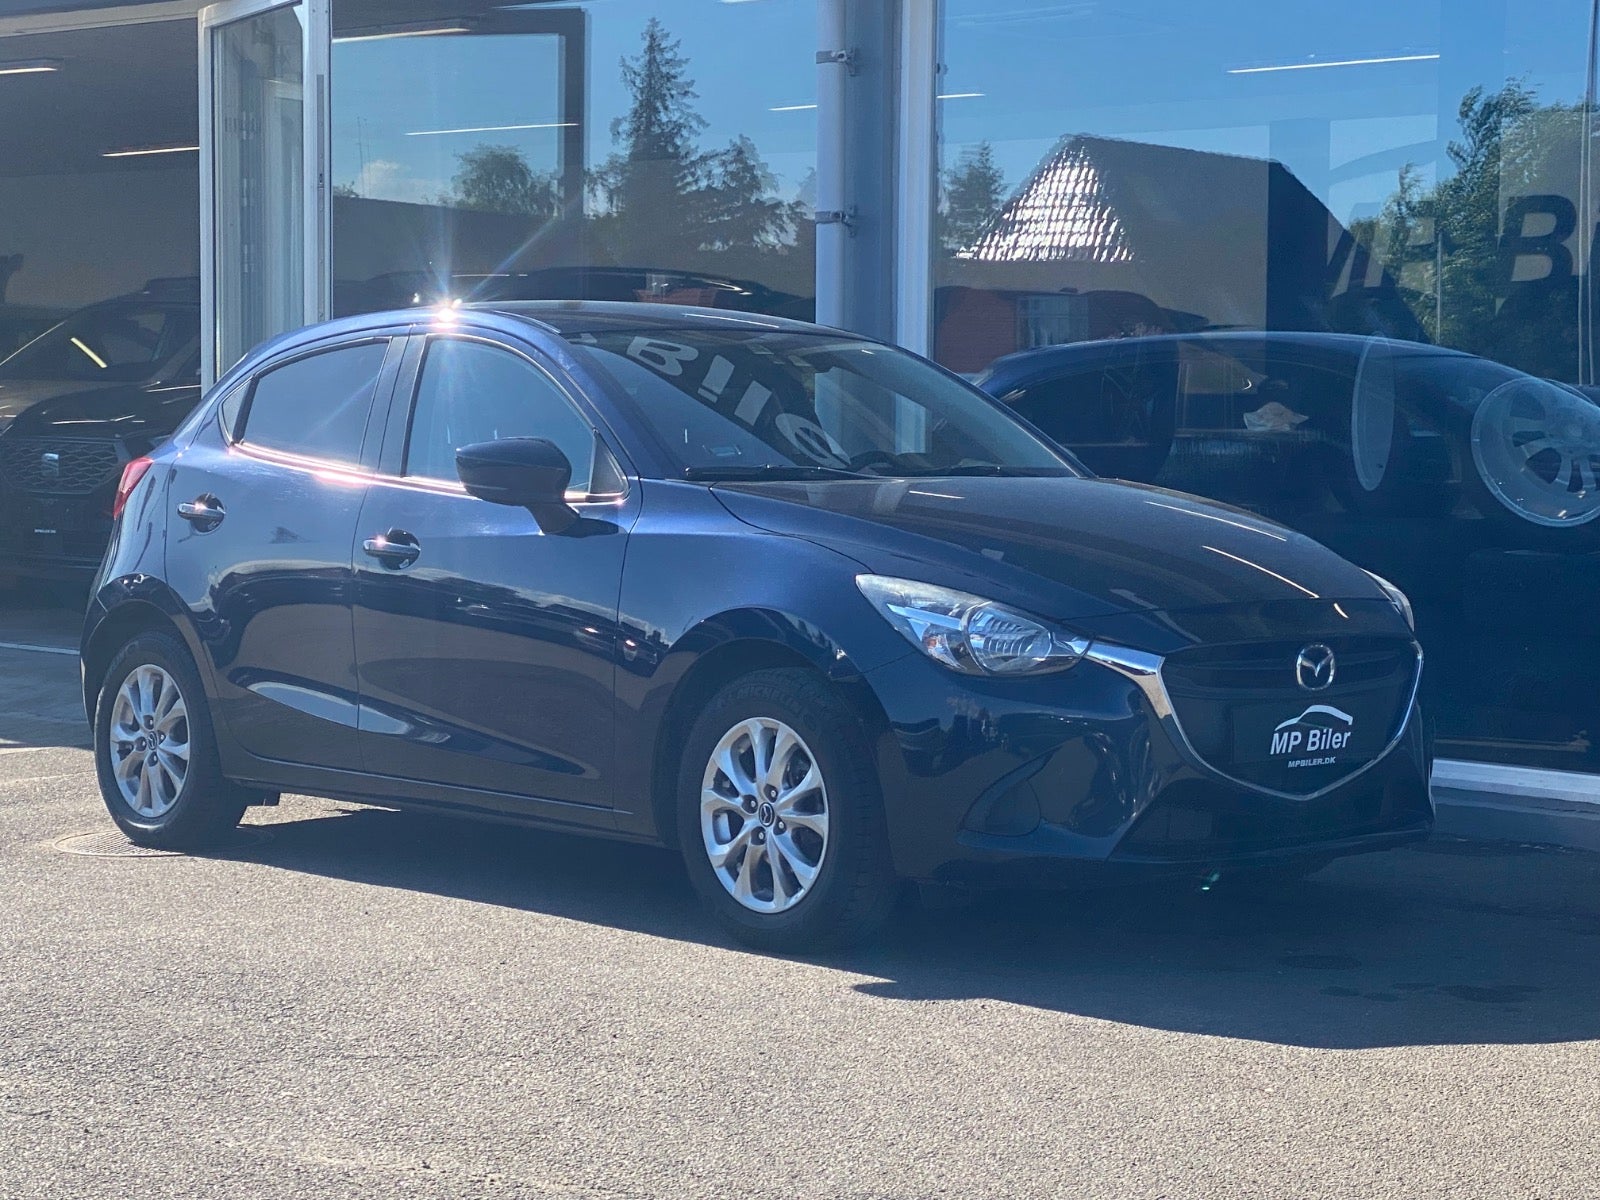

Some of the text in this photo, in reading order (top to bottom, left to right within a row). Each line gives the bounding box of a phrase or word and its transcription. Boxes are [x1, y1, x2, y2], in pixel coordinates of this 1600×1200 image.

[1270, 729, 1351, 755] MP Biler
[1288, 757, 1336, 768] MPBILER.DK
